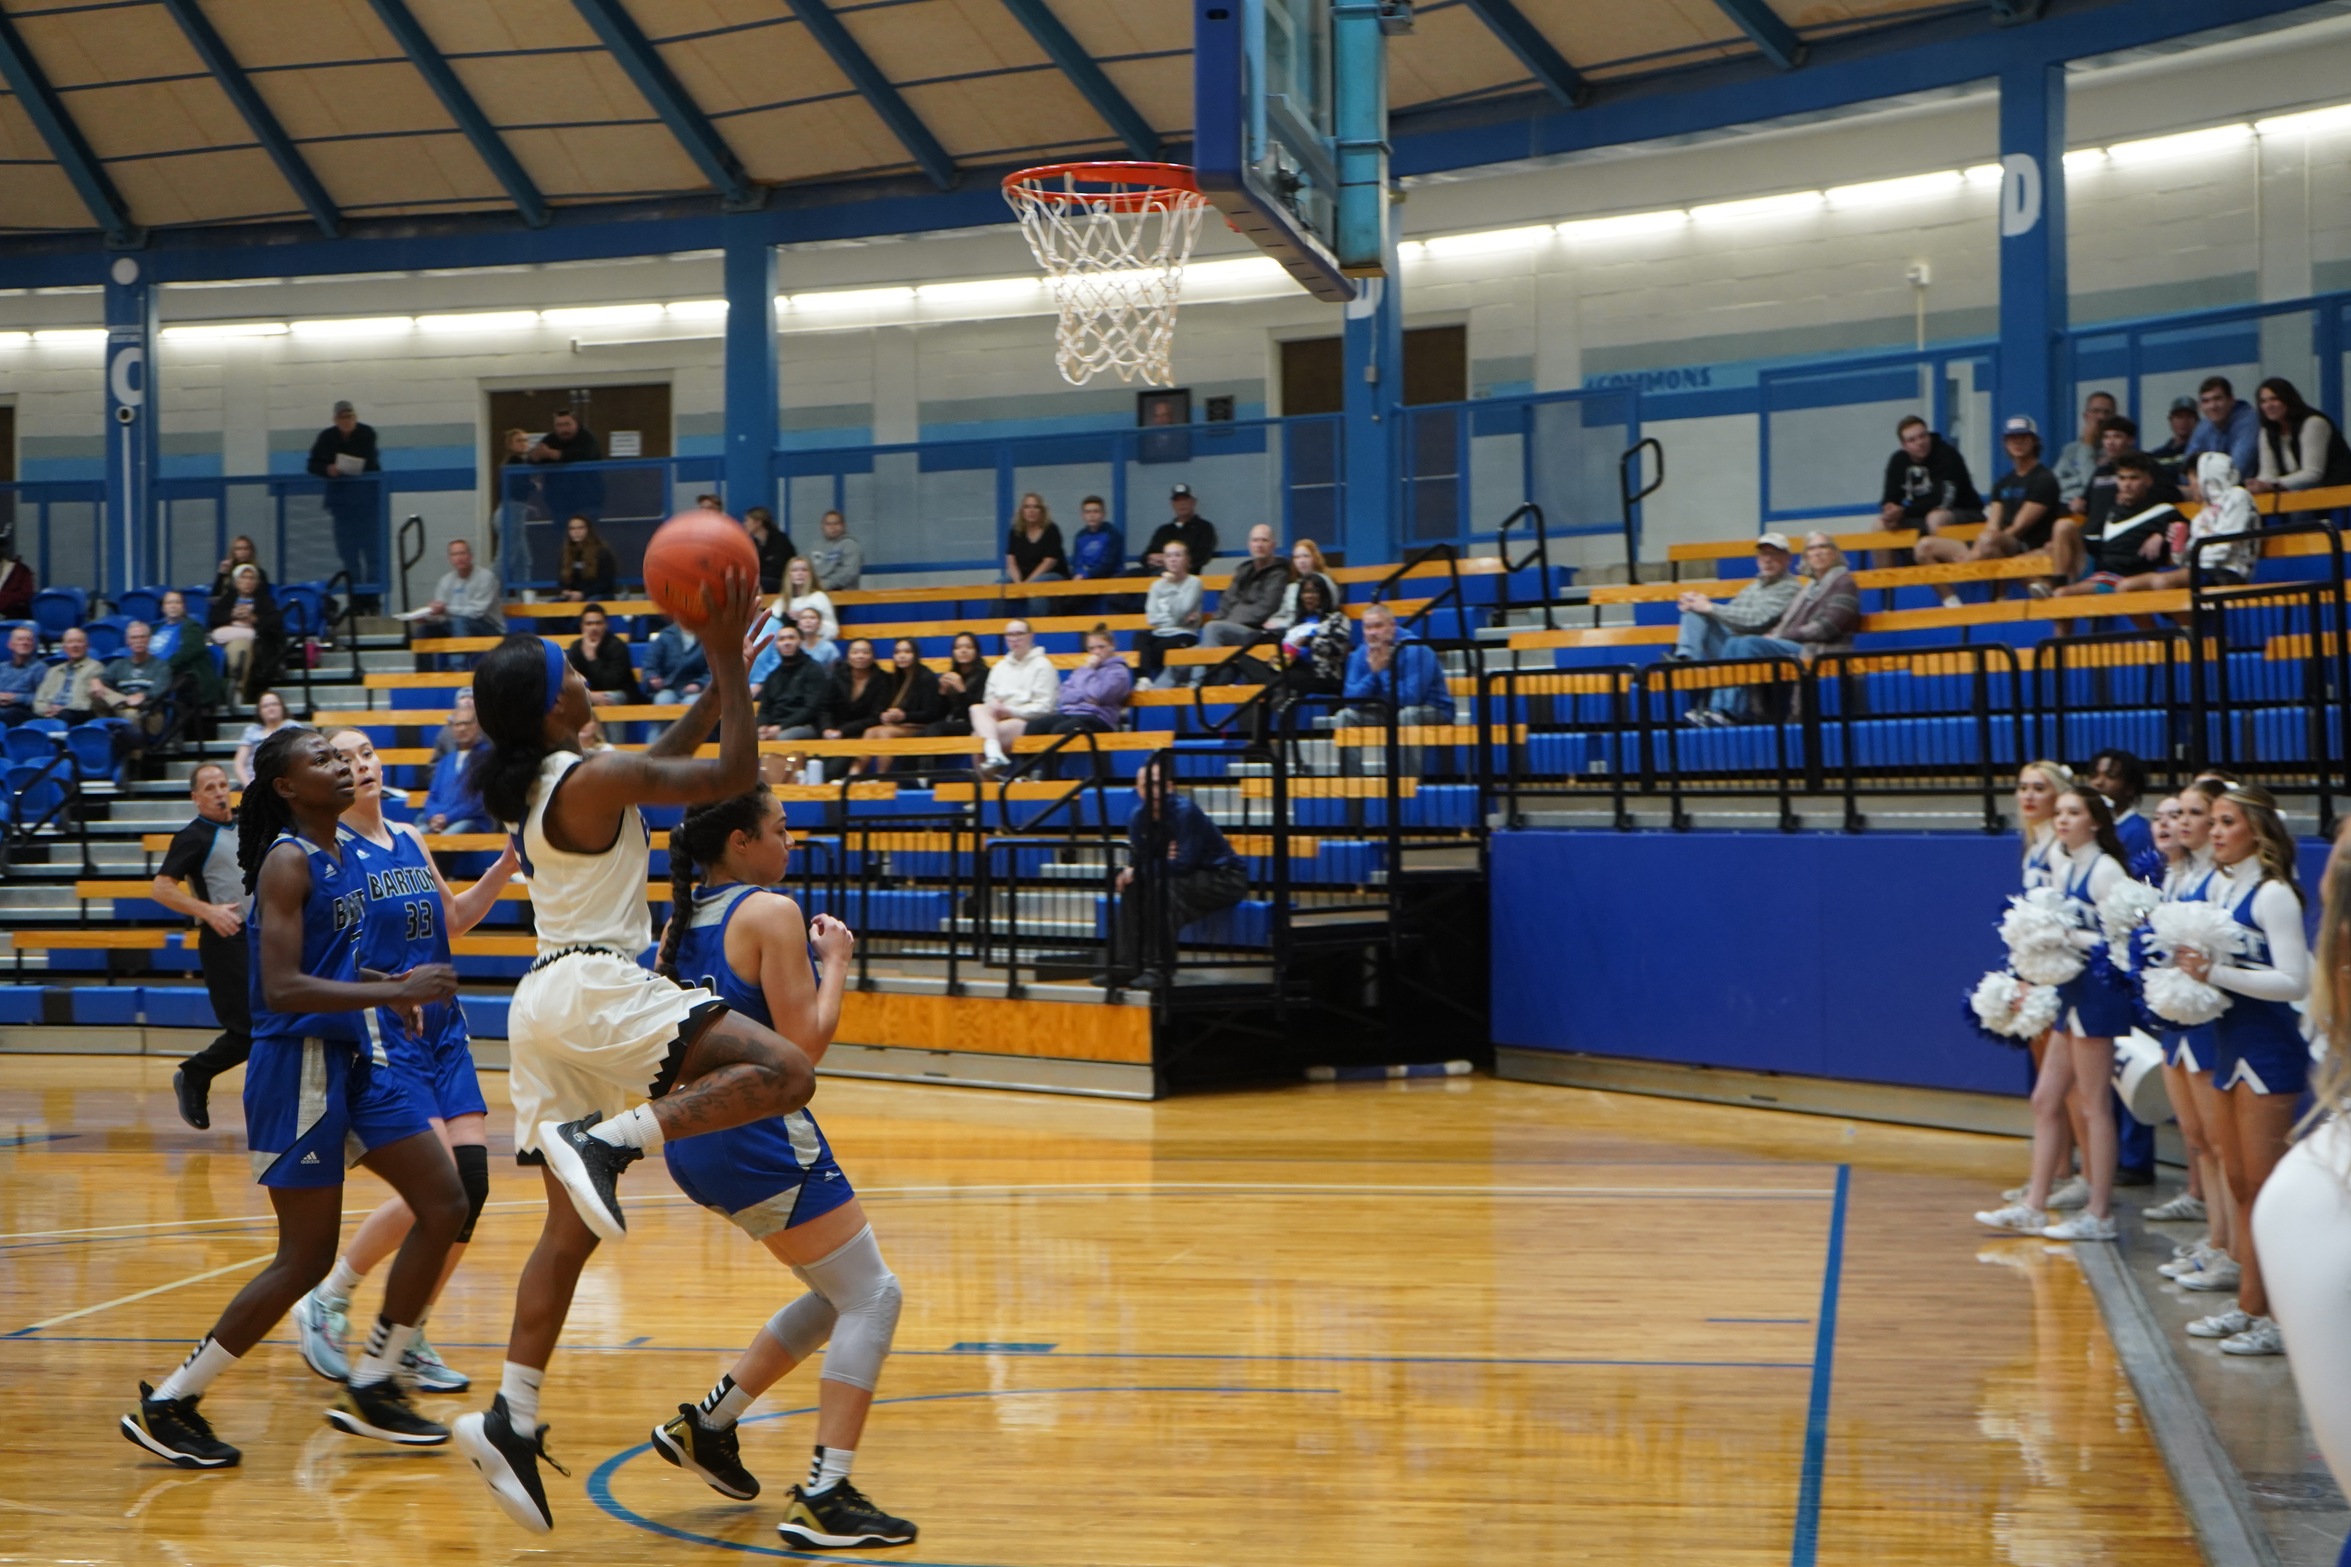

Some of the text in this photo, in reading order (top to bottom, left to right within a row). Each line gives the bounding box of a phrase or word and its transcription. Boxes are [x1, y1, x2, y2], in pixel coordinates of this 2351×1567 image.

[2003, 152, 2042, 236] D
[111, 346, 144, 407] C
[405, 899, 434, 942] 33
